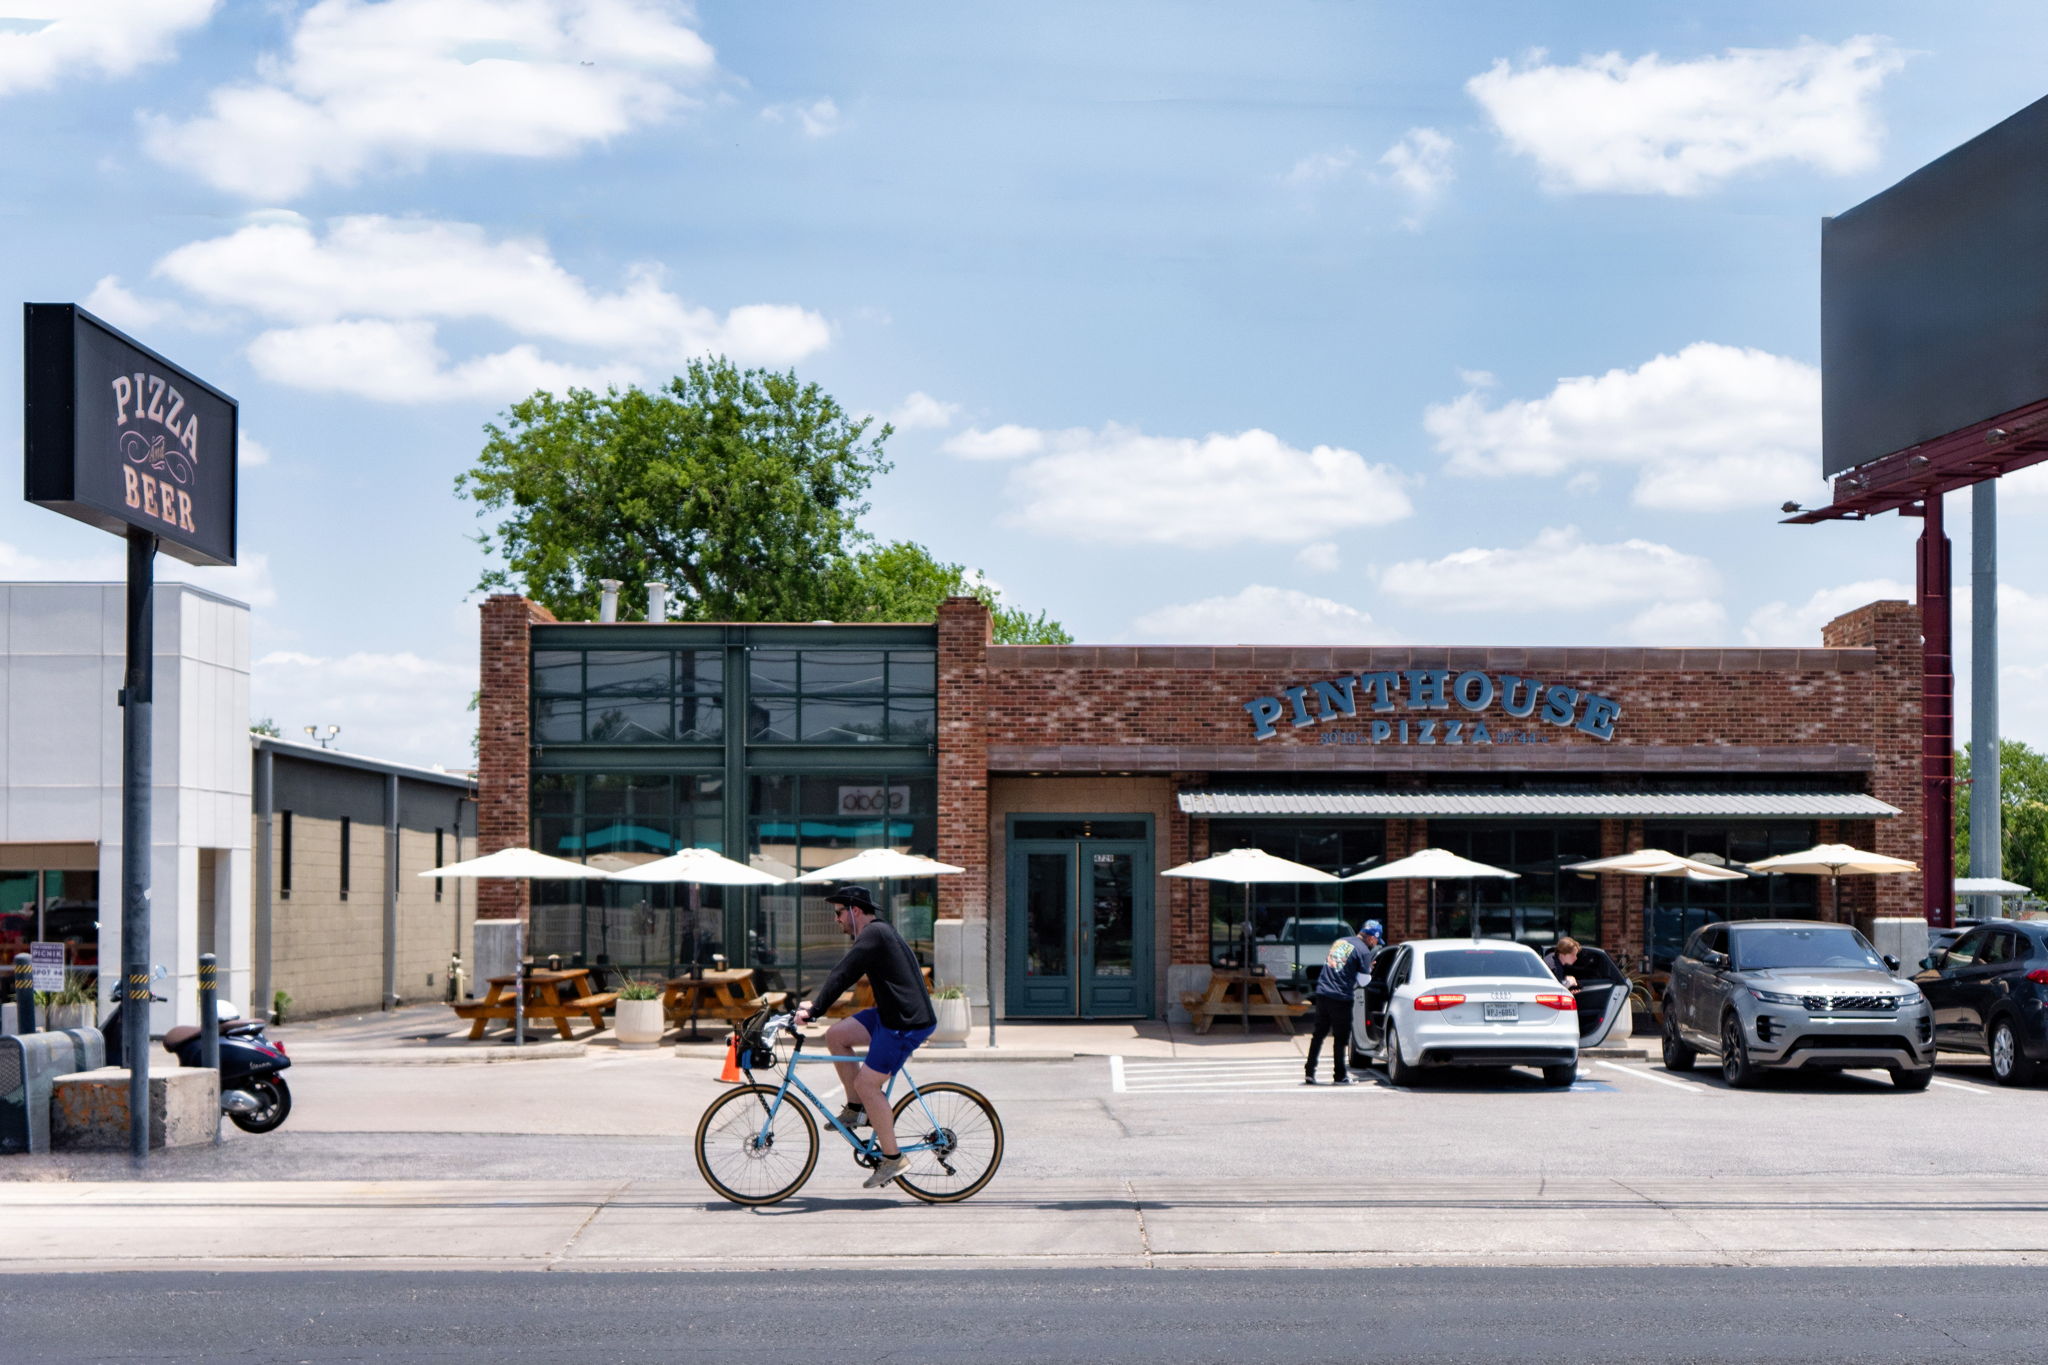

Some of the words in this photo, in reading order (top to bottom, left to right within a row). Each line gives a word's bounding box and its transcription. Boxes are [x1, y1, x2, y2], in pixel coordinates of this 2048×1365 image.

[112, 372, 199, 464] PIZZA
[122, 463, 196, 533] BEER
[1243, 670, 1622, 741] PINTHOUSE
[1371, 720, 1493, 744] PIZZA
